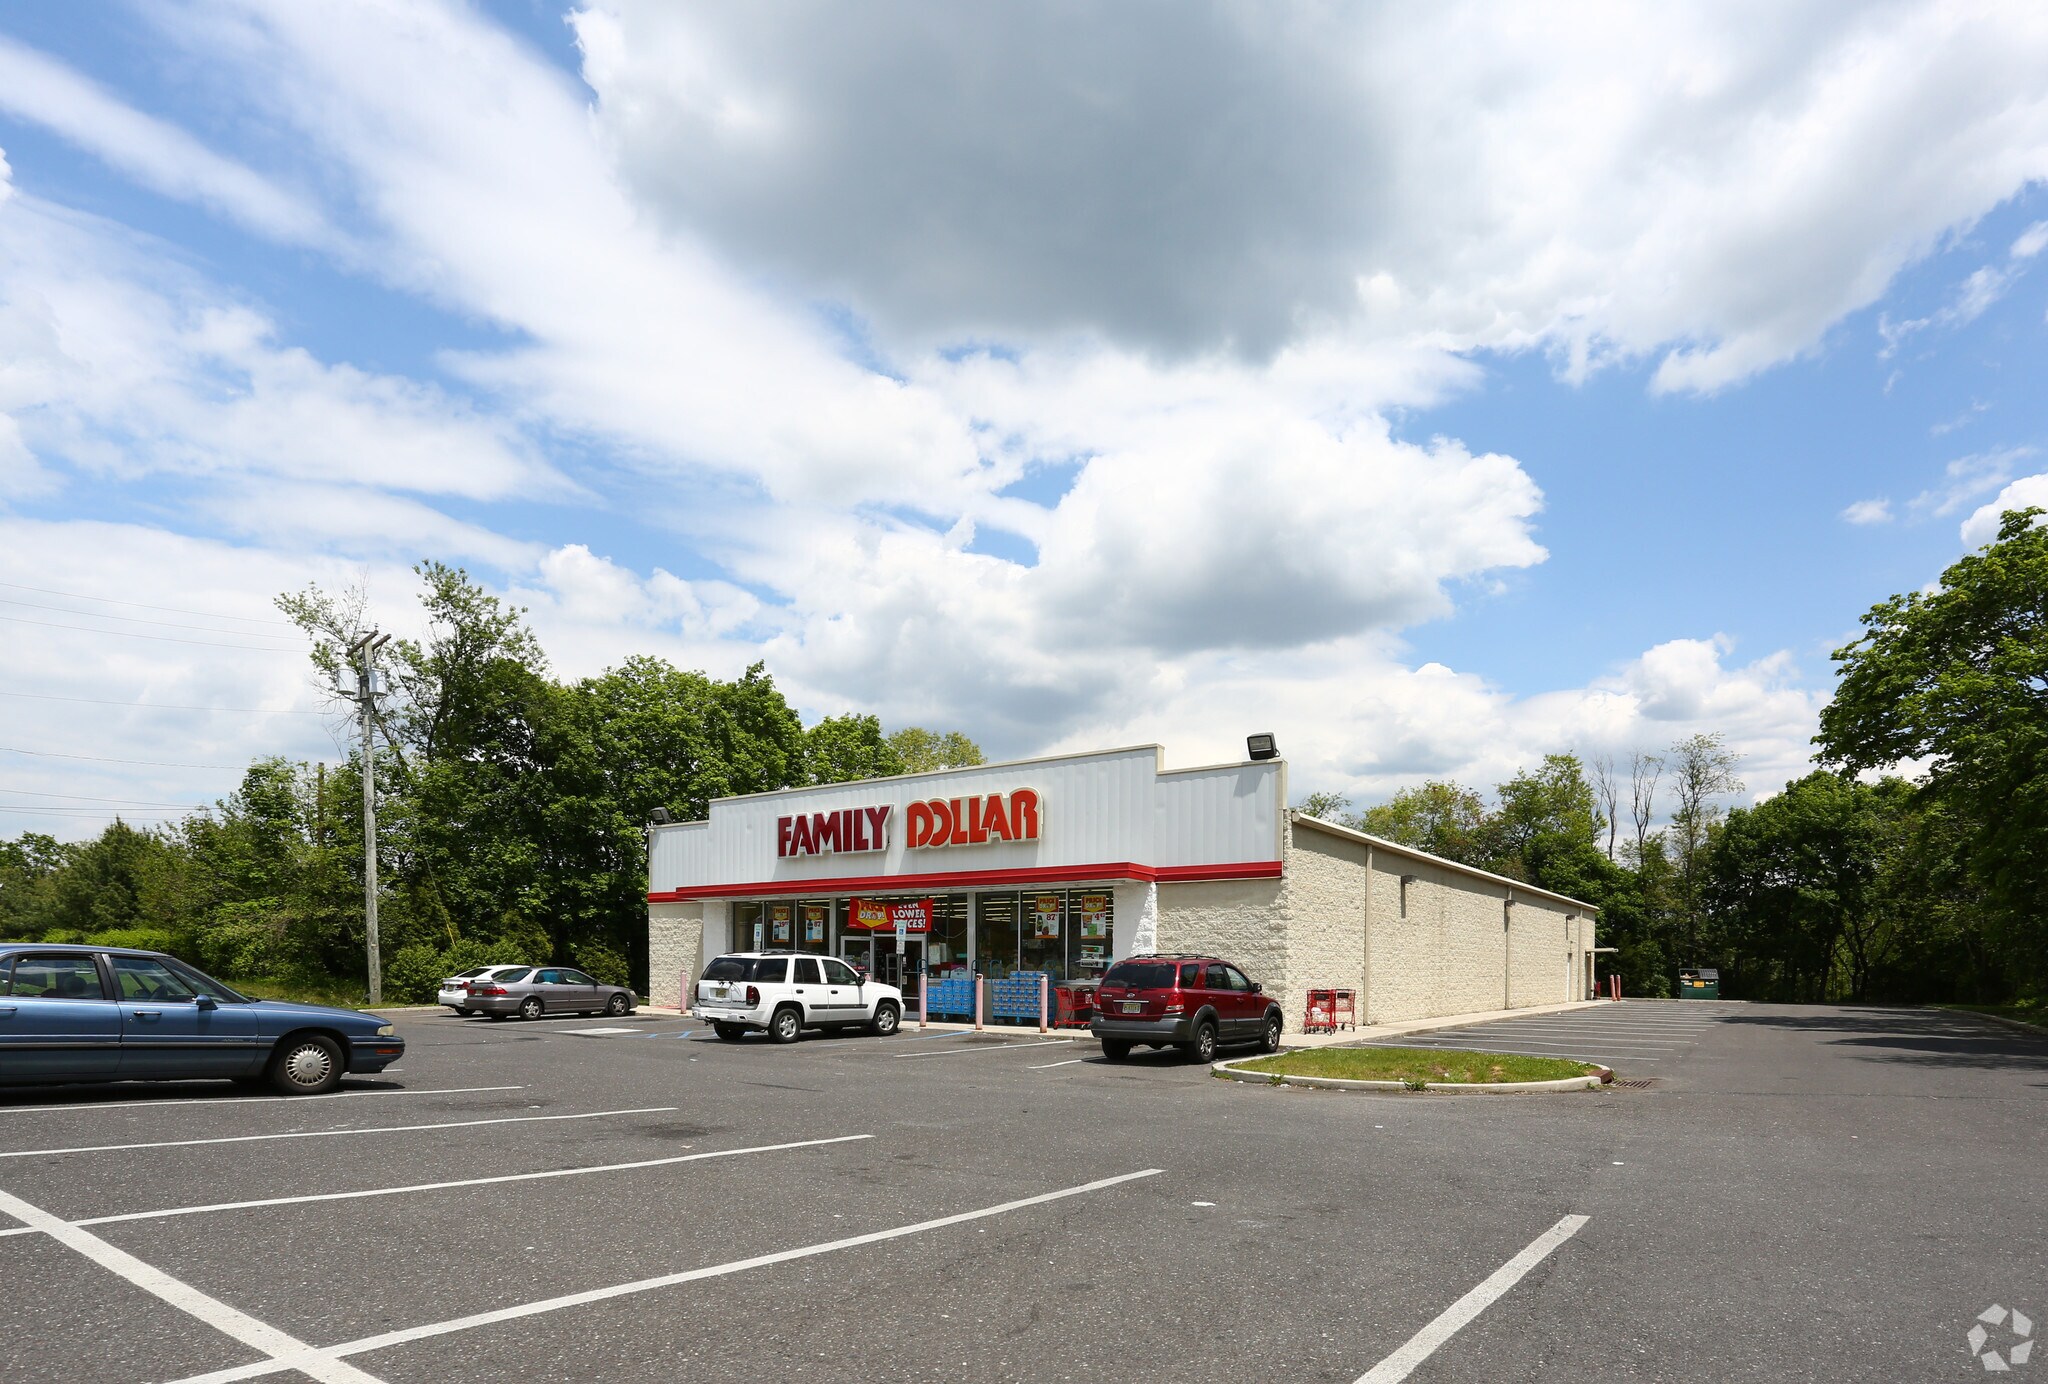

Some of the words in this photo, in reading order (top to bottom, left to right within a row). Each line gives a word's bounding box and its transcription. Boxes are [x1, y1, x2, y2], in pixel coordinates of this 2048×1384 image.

[778, 805, 891, 858] FAMILY
[906, 789, 1039, 849] DOLLAR
[892, 909, 926, 918] LOWER
[893, 918, 926, 928] PCES!
